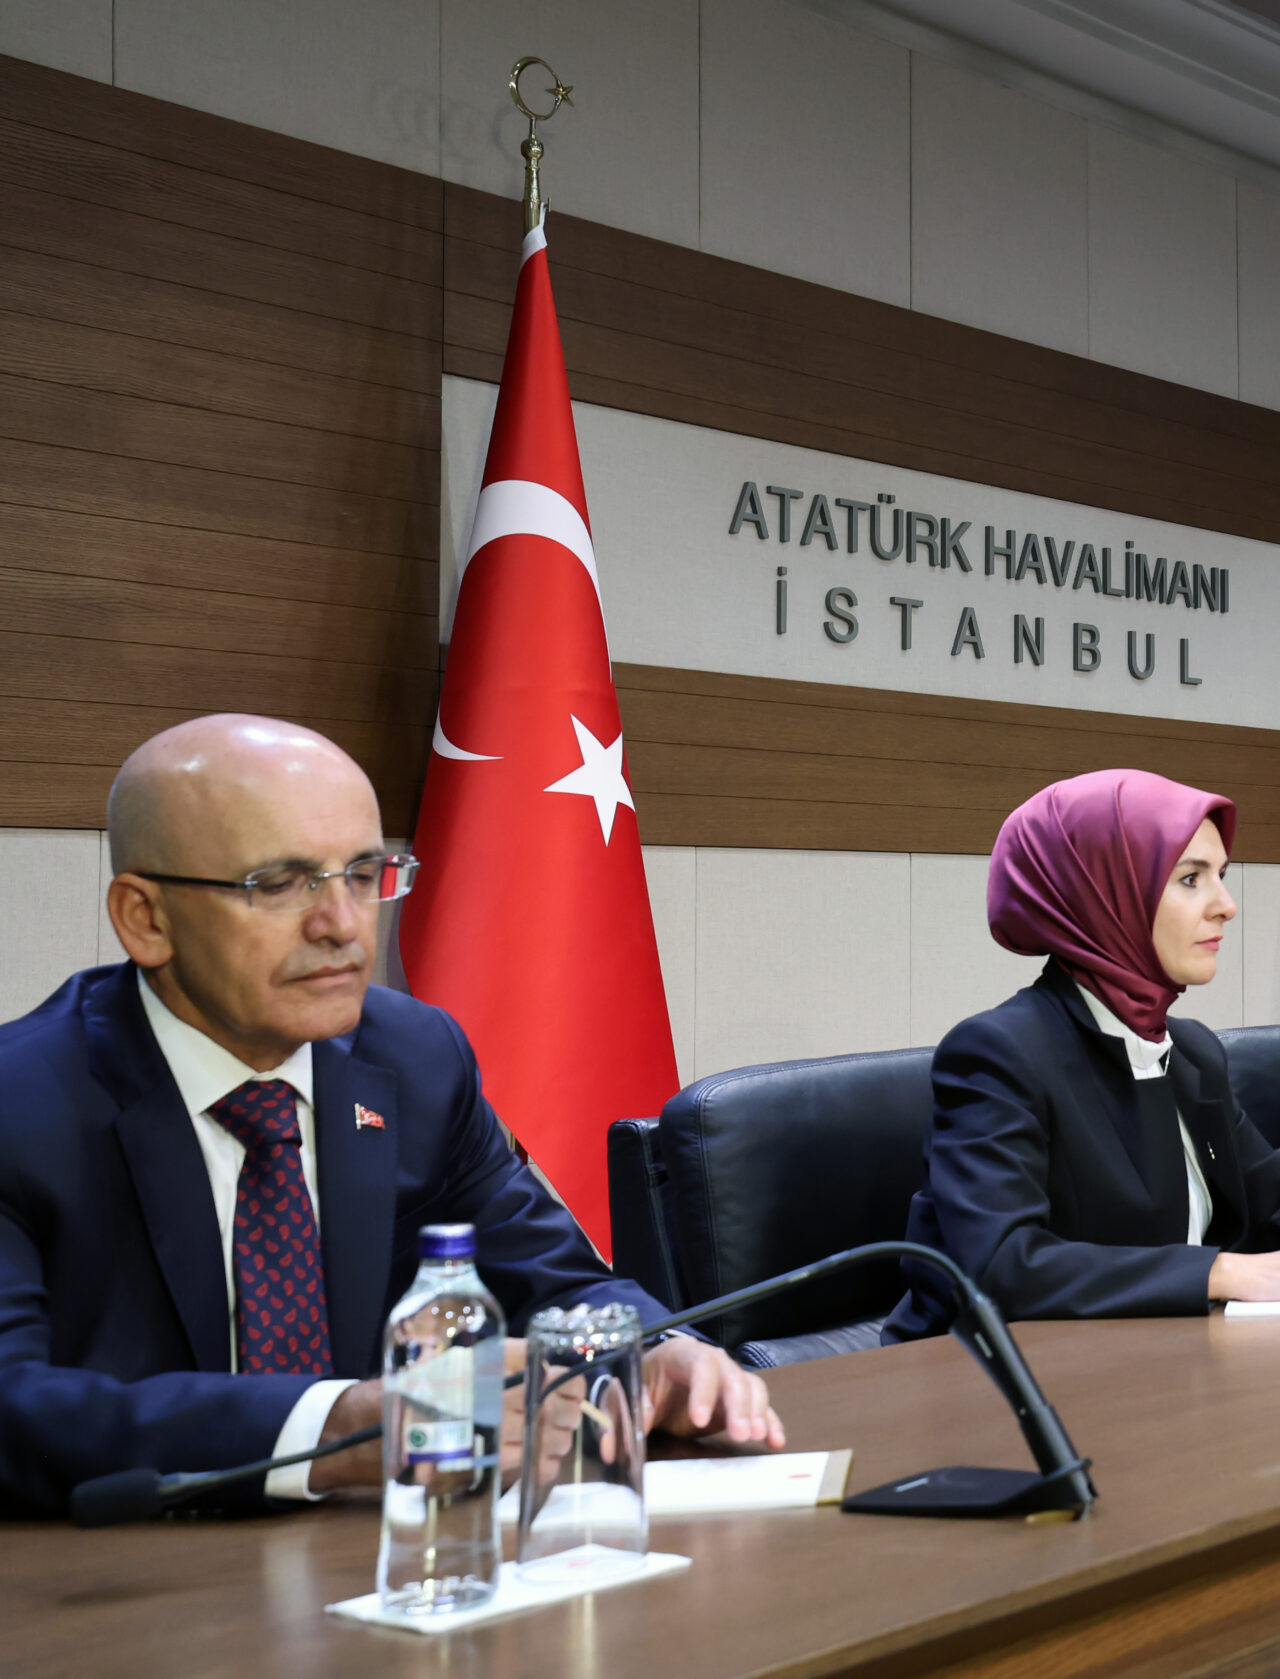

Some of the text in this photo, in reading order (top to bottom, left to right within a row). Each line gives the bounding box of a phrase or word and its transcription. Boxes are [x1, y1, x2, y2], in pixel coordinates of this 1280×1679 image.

[729, 481, 1230, 614] ATATÜRK HAVALİMANI
[776, 566, 1203, 686] İSTANBUL
